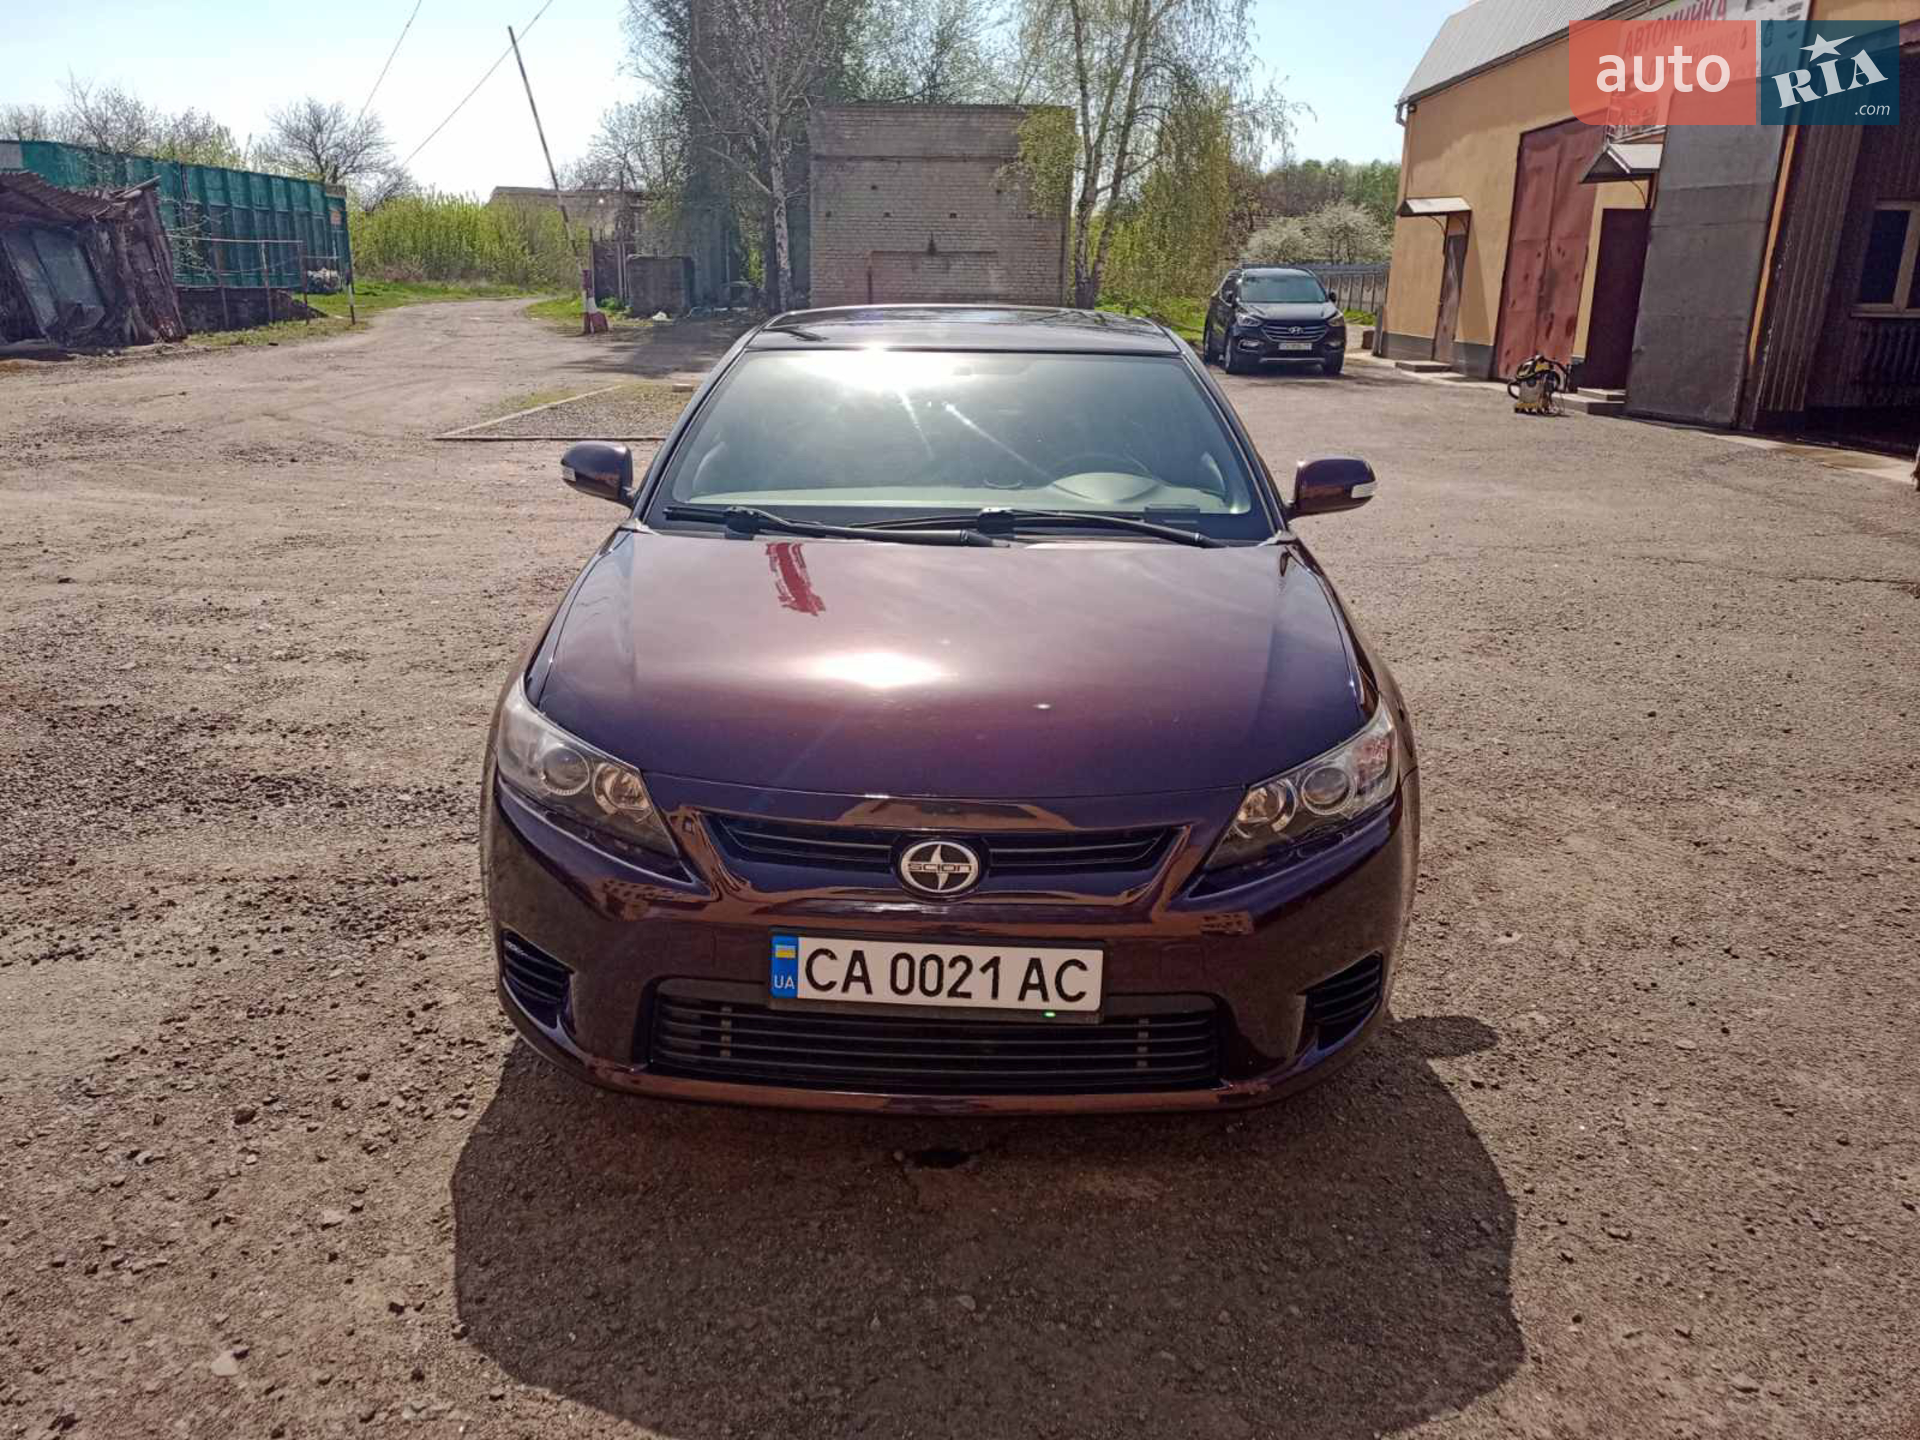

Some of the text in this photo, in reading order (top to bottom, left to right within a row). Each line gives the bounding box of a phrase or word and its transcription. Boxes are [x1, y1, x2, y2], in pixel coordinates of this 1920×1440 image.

[774, 975, 795, 990] UA
[805, 948, 1089, 1003] CA 0021 AC
